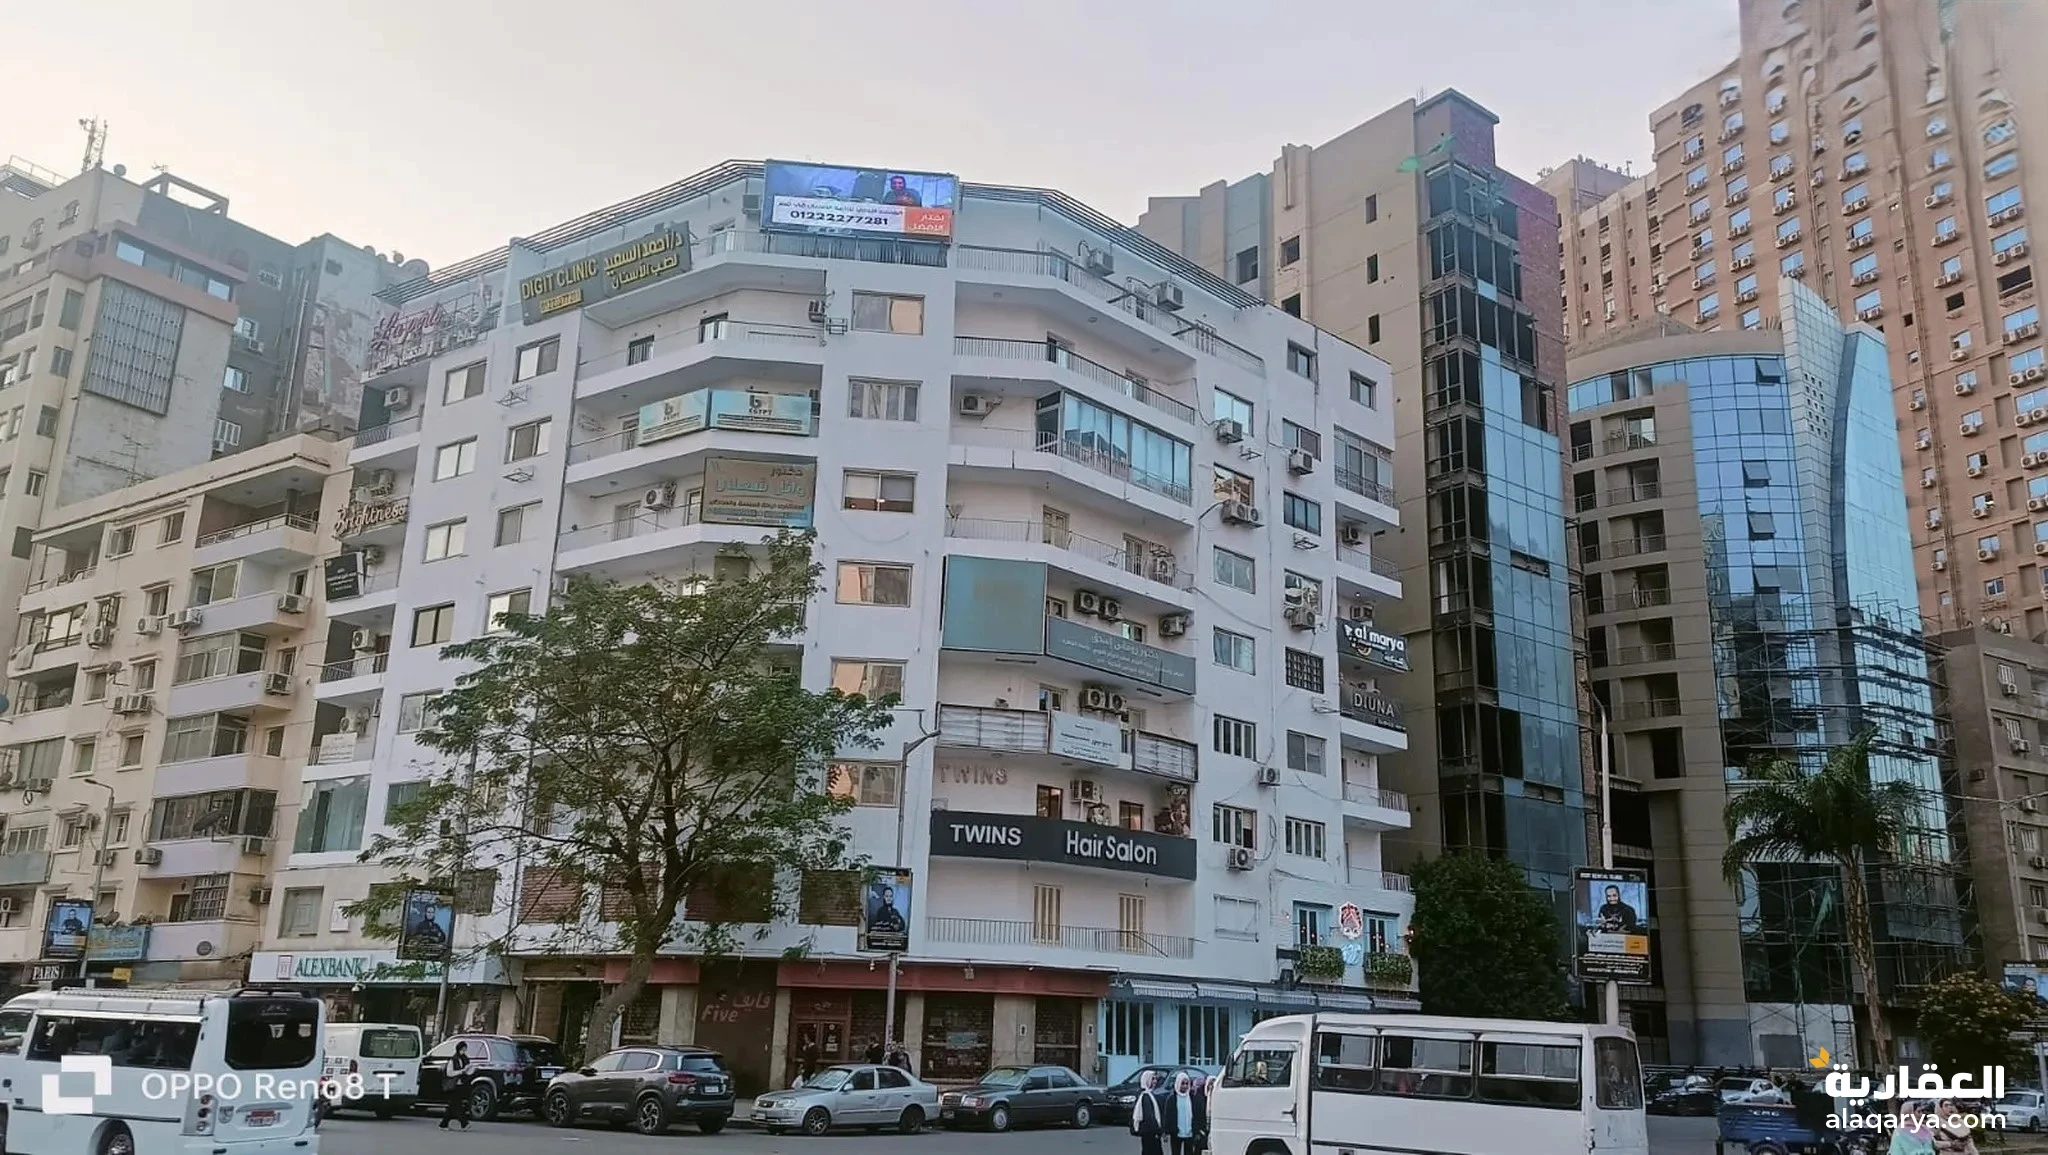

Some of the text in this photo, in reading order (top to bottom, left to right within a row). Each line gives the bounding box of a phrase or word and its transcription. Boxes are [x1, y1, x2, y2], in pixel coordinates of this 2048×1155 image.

[790, 210, 888, 226] 01222277281
[603, 244, 642, 275] السعيد
[521, 257, 598, 300] DIGIT CLINIC
[770, 466, 803, 478] دكتور
[334, 502, 406, 536] Brightness
[1354, 625, 1367, 640] al
[1369, 631, 1405, 652] marya
[1354, 693, 1395, 717] DIUNA
[940, 764, 1008, 785] TWINS
[950, 824, 1023, 846] TWINS
[1066, 829, 1157, 865] Hair Salon
[32, 965, 60, 980] PARIS
[294, 957, 369, 979] ALEXBANK
[701, 1004, 739, 1023] Five
